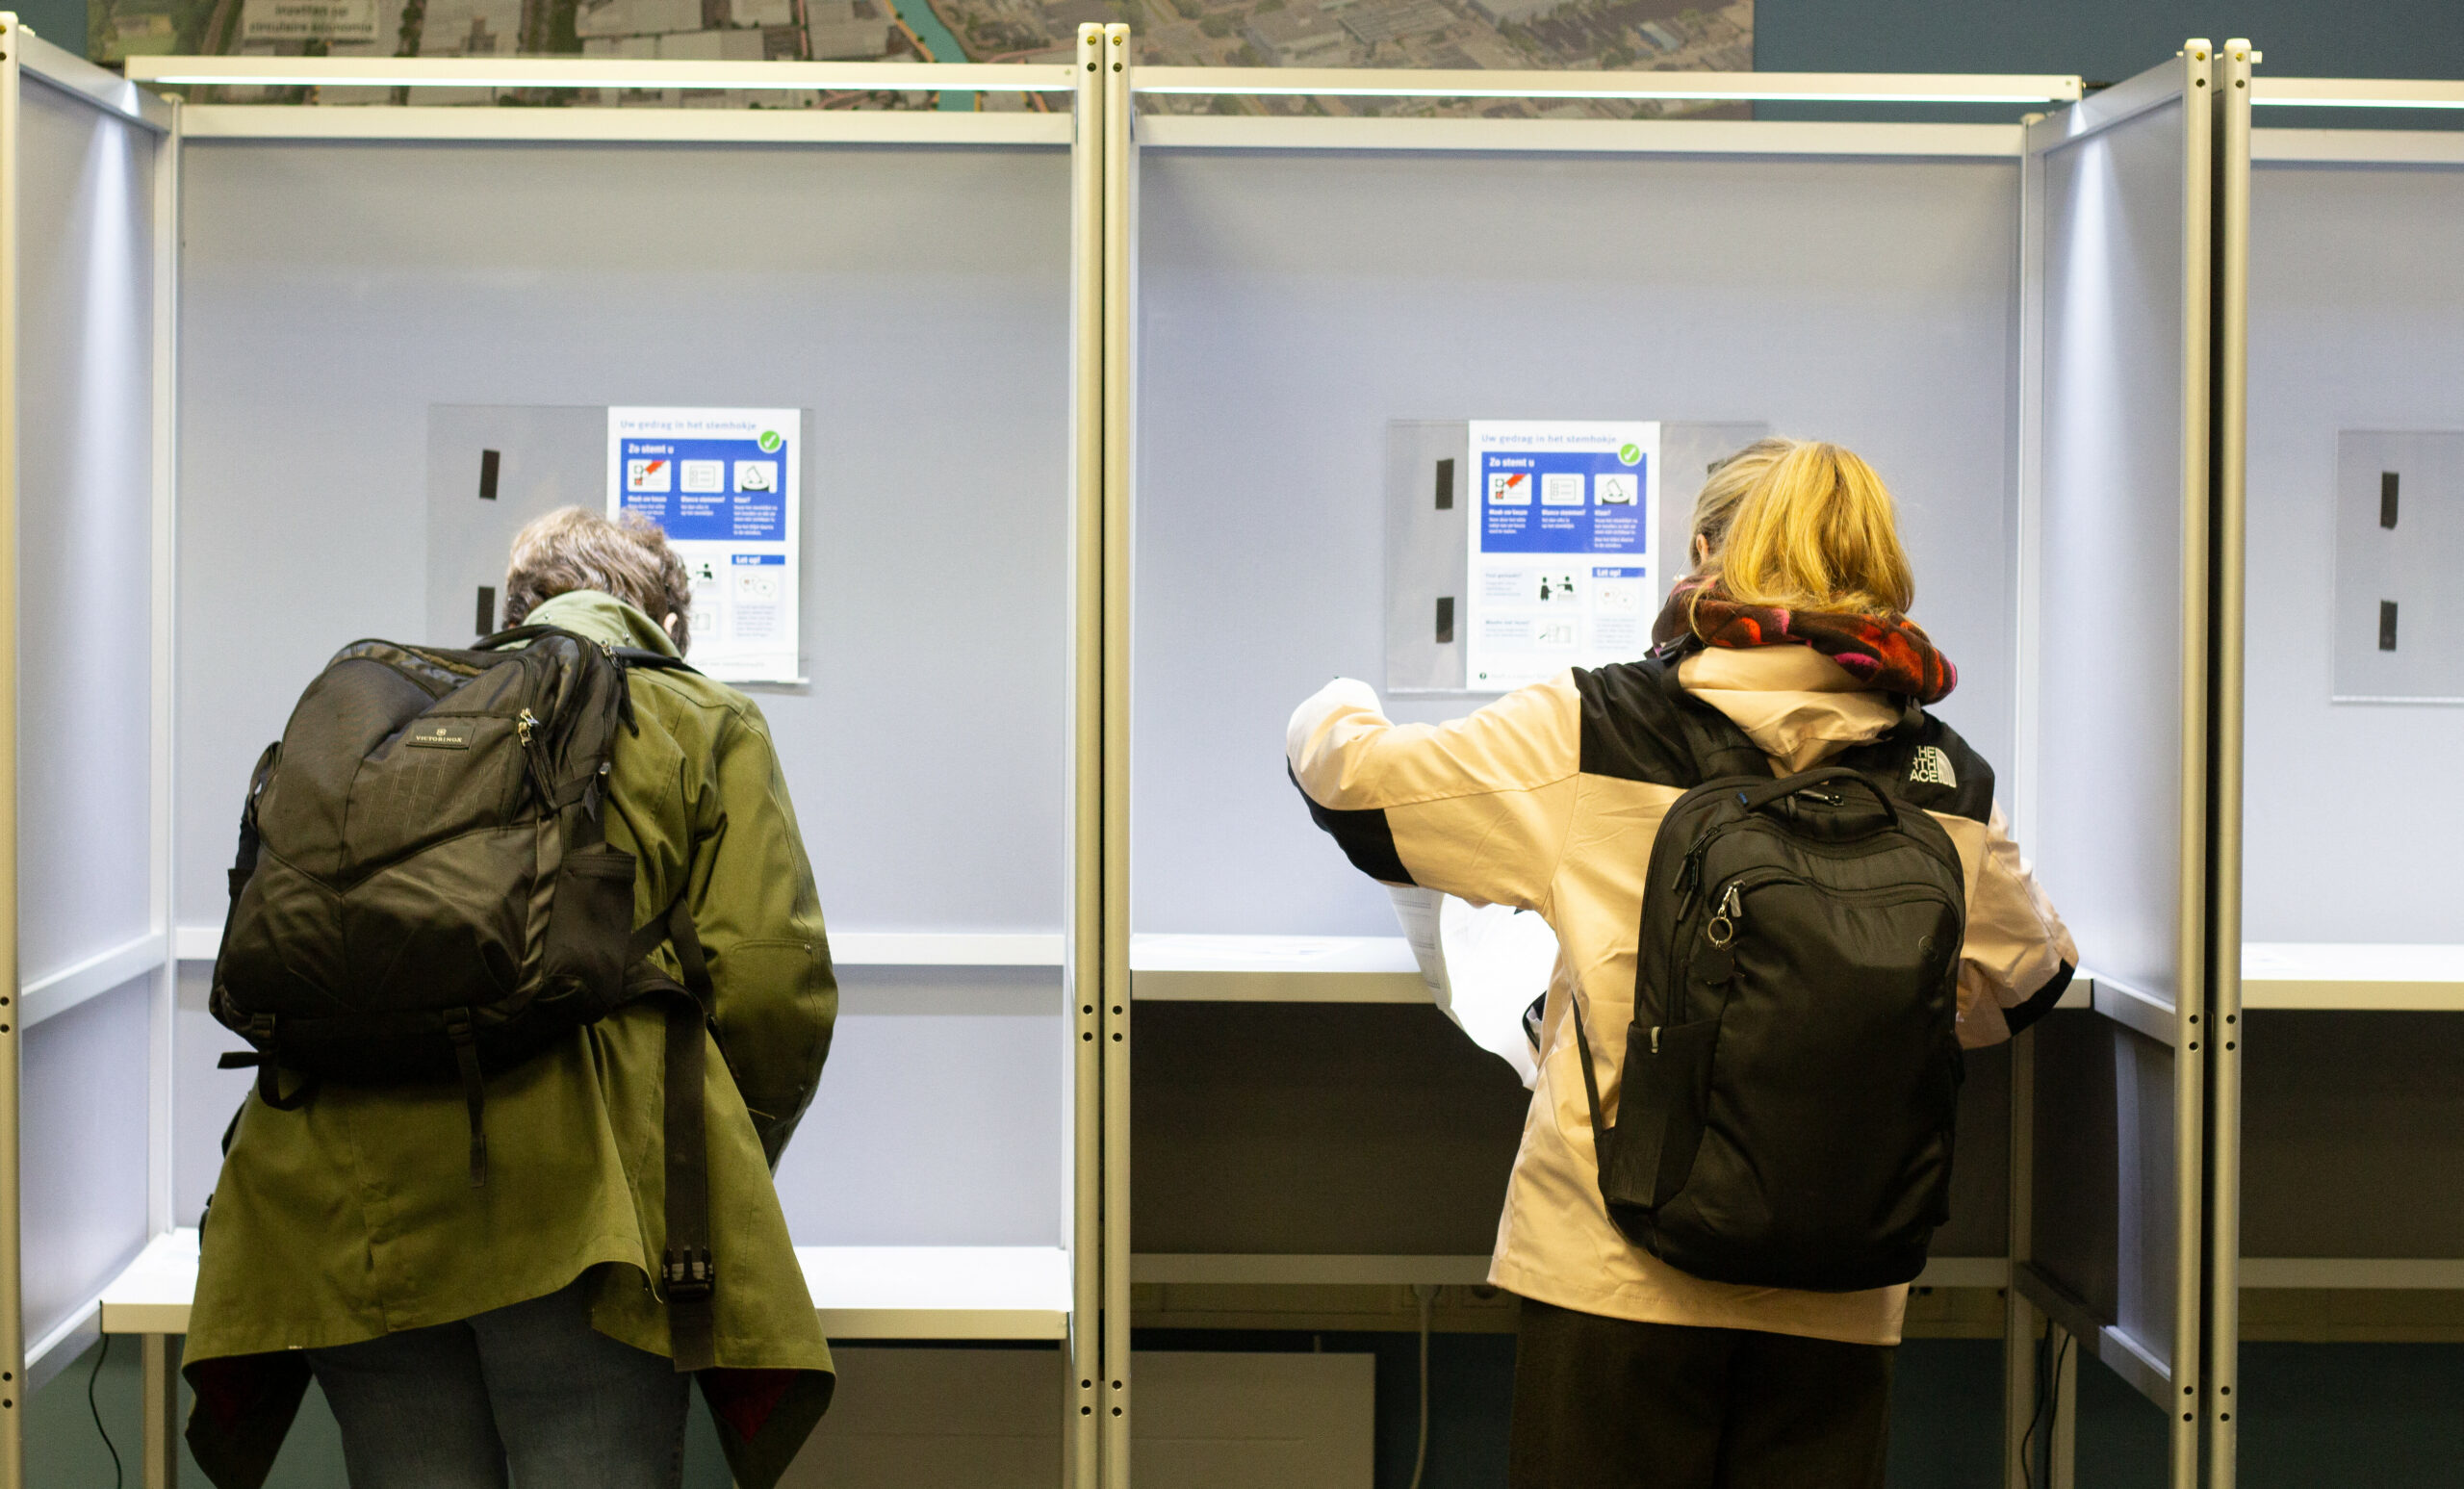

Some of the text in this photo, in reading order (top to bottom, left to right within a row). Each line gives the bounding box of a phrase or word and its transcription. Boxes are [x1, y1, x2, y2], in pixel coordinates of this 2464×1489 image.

[620, 421, 757, 431] Uw gedrag in het stemhokje
[1481, 435, 1617, 446] Uw gedrag in het stemhokje
[628, 443, 674, 454] Zo stemt u
[1489, 457, 1535, 468] Zo stemt u
[735, 555, 748, 564] Let
[1596, 568, 1622, 578] Let op!
[416, 734, 463, 743] VICTORINOX
[1917, 745, 1936, 759] HE
[1910, 769, 1938, 783] ACE
